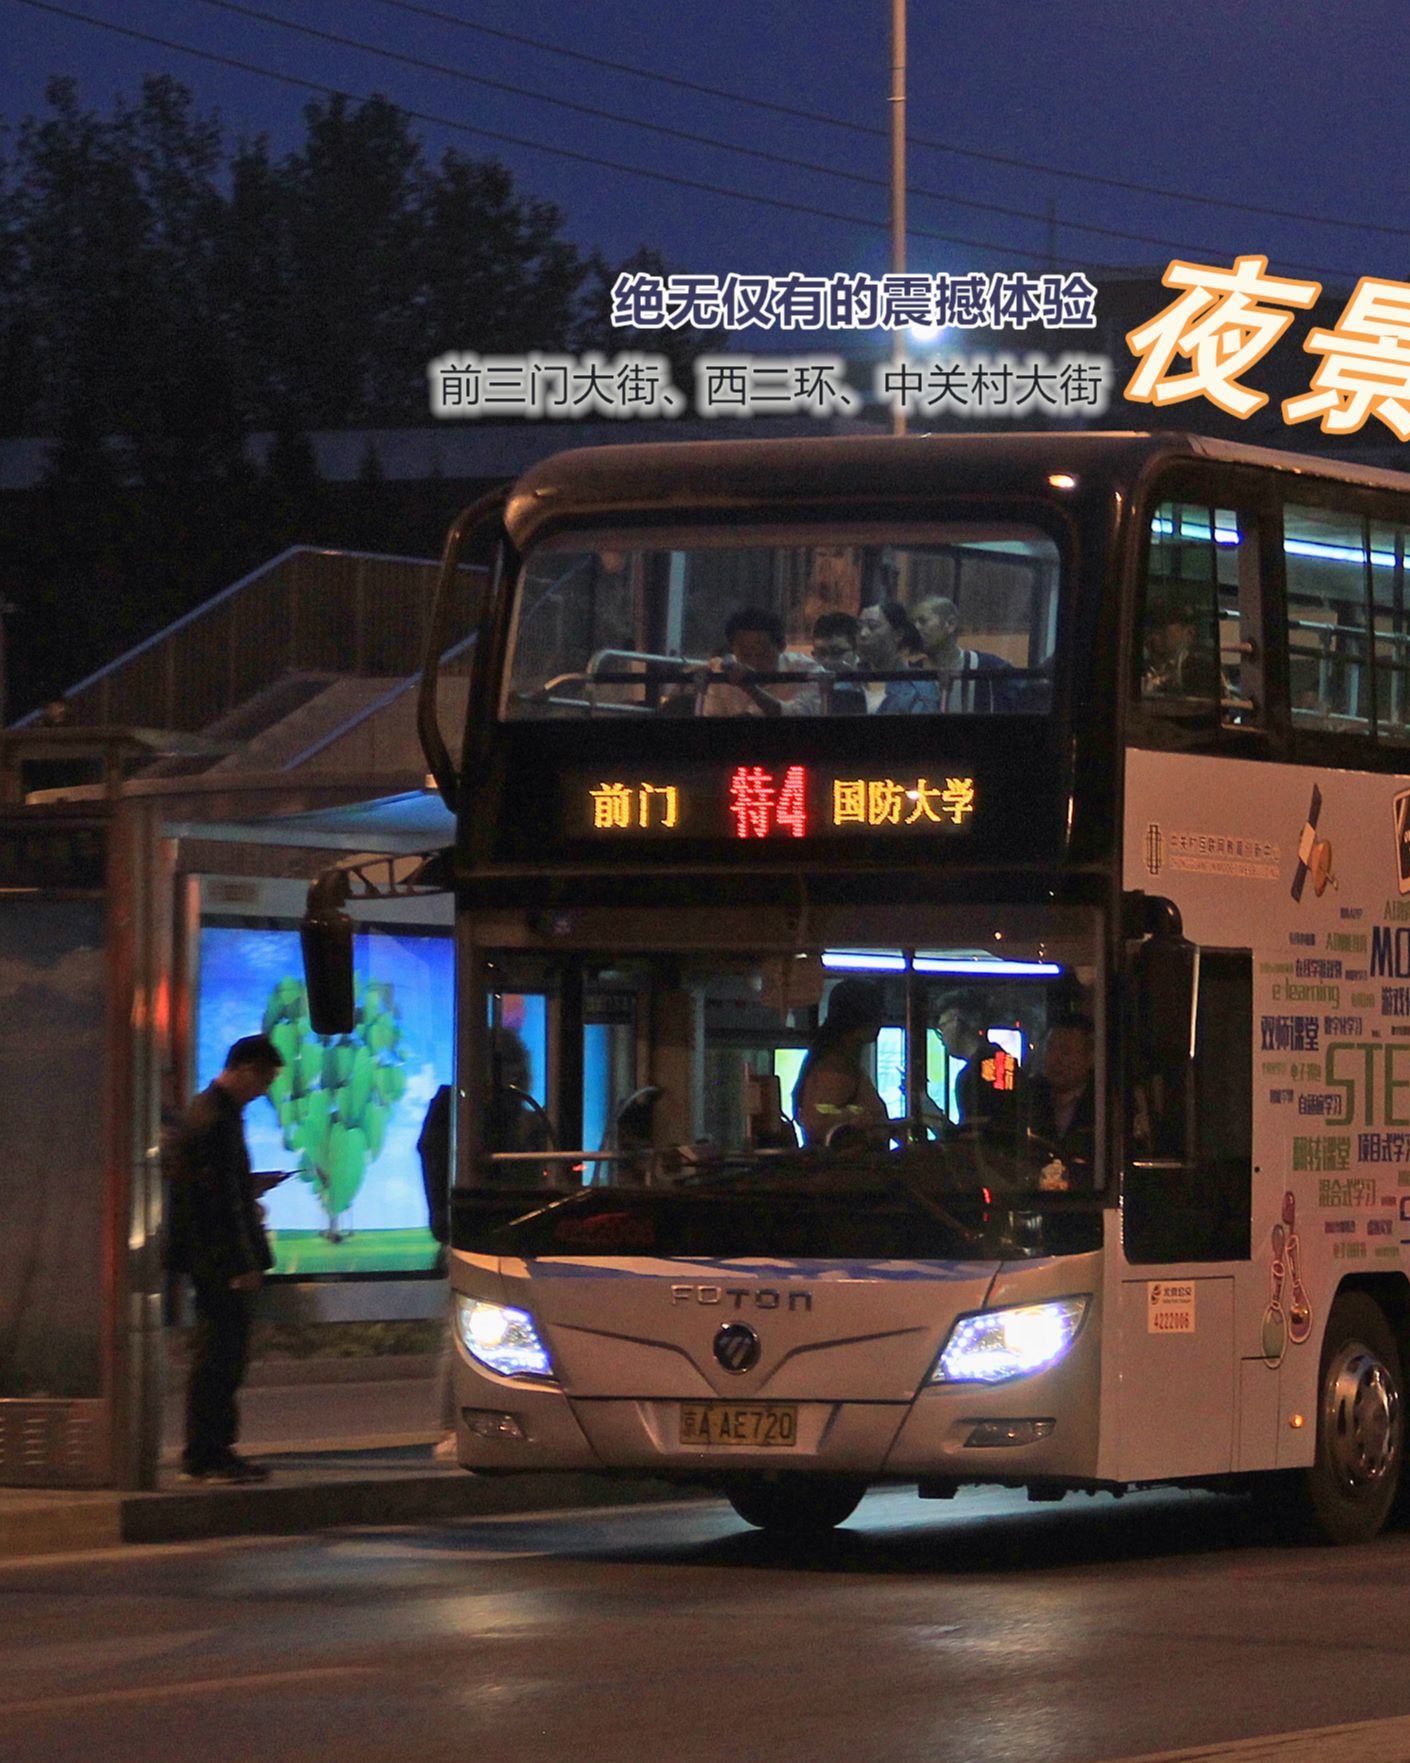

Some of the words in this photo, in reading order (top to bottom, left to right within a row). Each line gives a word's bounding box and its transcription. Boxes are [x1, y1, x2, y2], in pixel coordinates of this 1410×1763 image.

[588, 782, 679, 828] 前门
[729, 766, 807, 838] 特4
[832, 777, 974, 825] 国防大学
